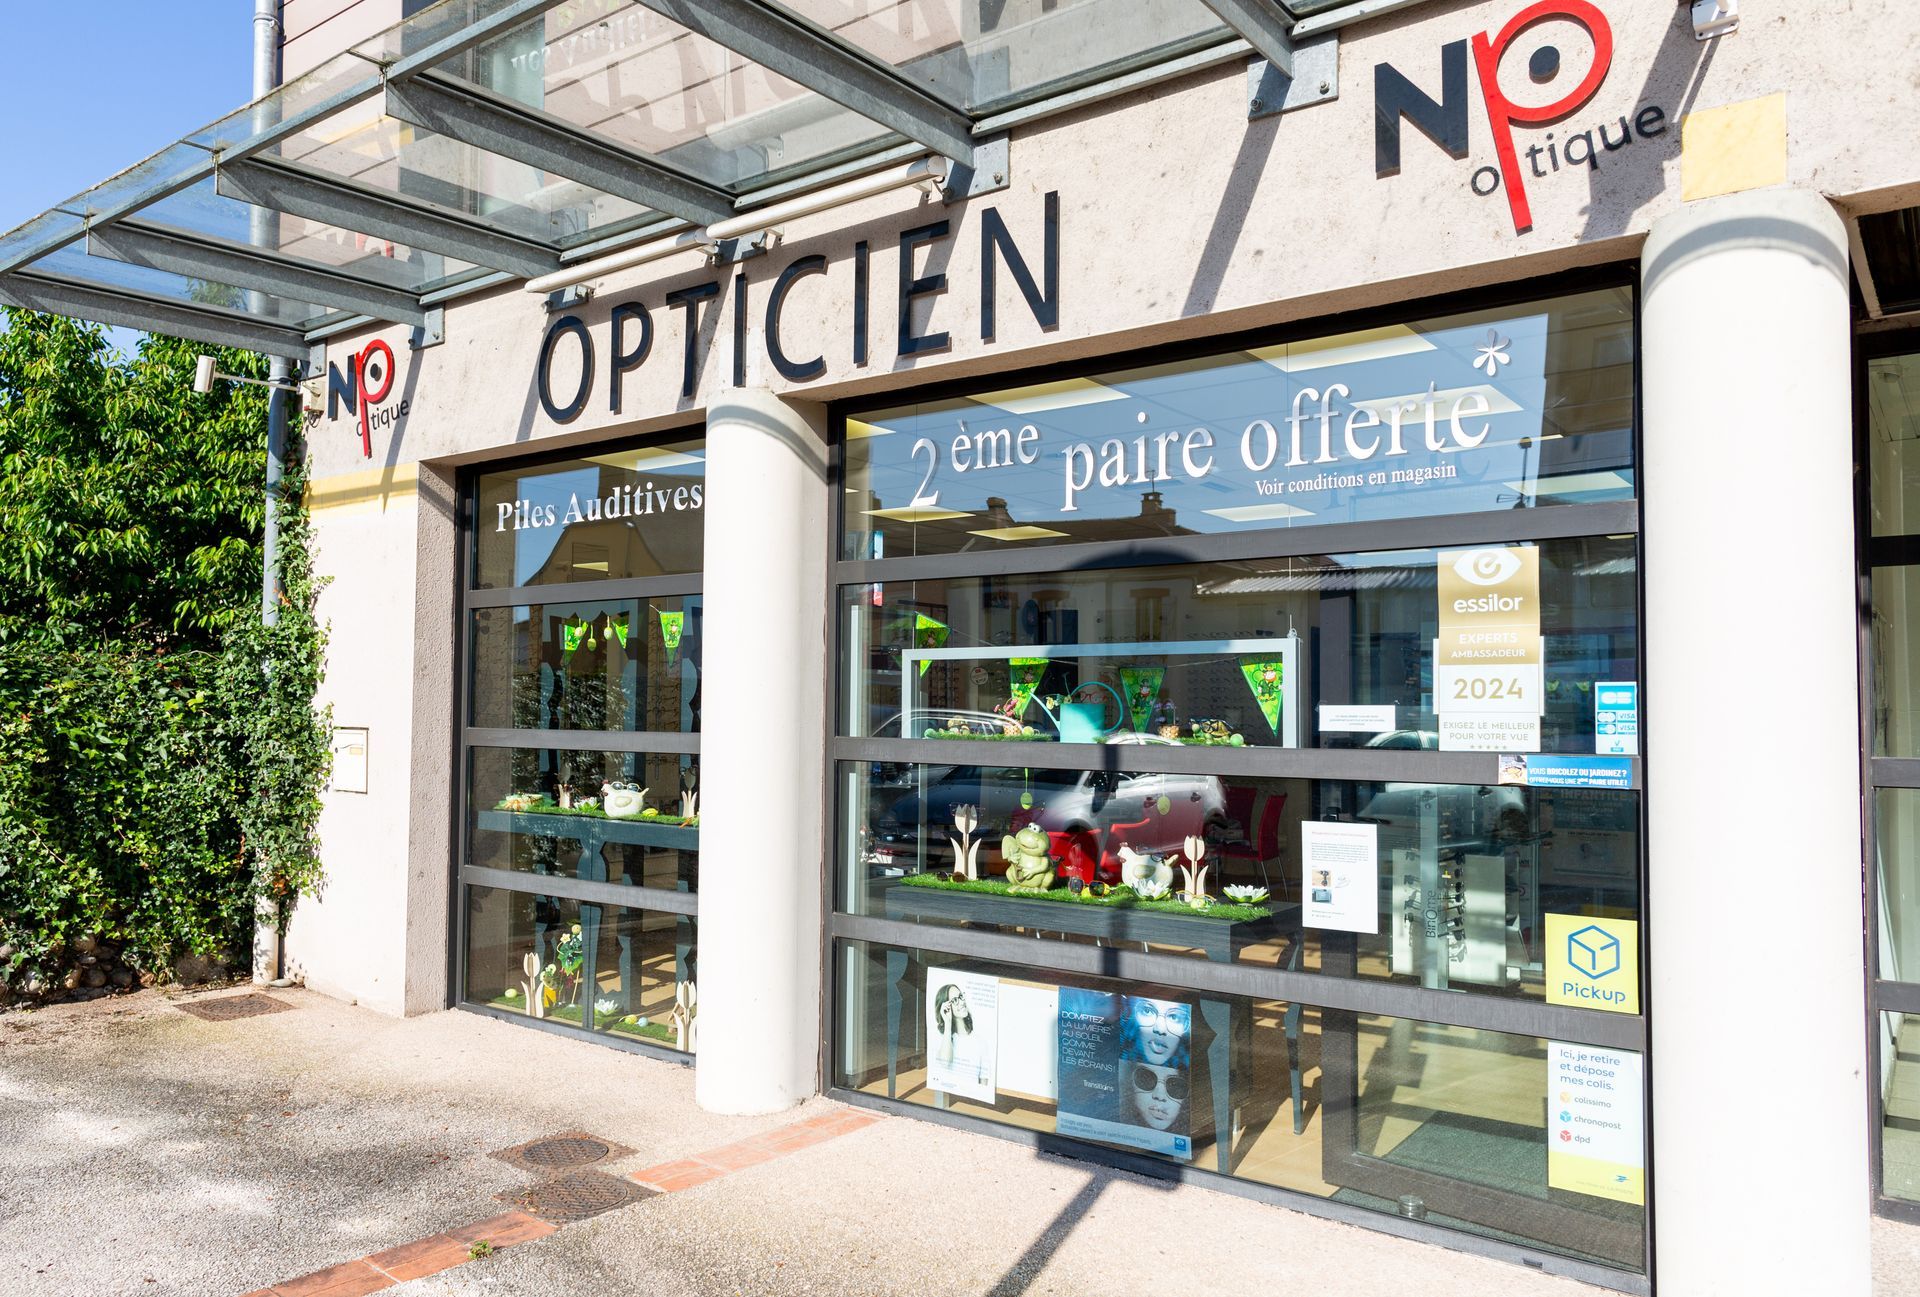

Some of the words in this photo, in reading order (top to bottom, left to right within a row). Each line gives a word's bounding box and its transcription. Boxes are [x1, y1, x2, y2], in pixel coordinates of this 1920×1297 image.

[538, 190, 1059, 423] OPTICIEN
[1060, 412, 1214, 511] paire
[1255, 479, 1284, 496] Voir
[1288, 472, 1364, 493] conditions
[1369, 473, 1387, 485] en
[1391, 463, 1457, 488] magasin
[496, 499, 556, 532] Piles
[562, 482, 703, 525] Auditives
[1454, 594, 1523, 613] essilor
[1459, 632, 1518, 644] EXPERTS
[1451, 648, 1526, 658] AMBASSADEUR
[1454, 678, 1523, 700] 2024
[1443, 721, 1474, 730] EXIGEZ
[1477, 721, 1488, 730] LE
[1492, 721, 1536, 730] MEILLEUR
[1449, 732, 1474, 741] POUR
[1477, 732, 1507, 741] VOTRE
[1510, 733, 1529, 741] VUE
[1529, 767, 1546, 775] VOUS
[1547, 768, 1578, 776] BRICOLEZ
[1579, 768, 1589, 776] OU
[1589, 769, 1622, 778] JARDINEZ
[1563, 982, 1626, 1006] Pickup
[1061, 1011, 1105, 1024] DOMPTEZ
[1061, 1020, 1072, 1028] LA
[1061, 1029, 1074, 1038] AU
[1075, 1031, 1104, 1043] SOLEIL
[1061, 1037, 1096, 1050] COMME
[1061, 1046, 1096, 1059] DEVANT
[1560, 1049, 1575, 1061] Ici,
[1577, 1051, 1588, 1062] je
[1591, 1054, 1621, 1067] retire
[1061, 1055, 1077, 1065] LES
[1560, 1063, 1571, 1072] et
[1574, 1064, 1615, 1079] dépose
[1560, 1075, 1584, 1085] mes
[1586, 1079, 1614, 1091] colis.
[1574, 1096, 1612, 1109] colissimo
[1574, 1115, 1622, 1130] chronopost
[1574, 1134, 1591, 1145] dpd
